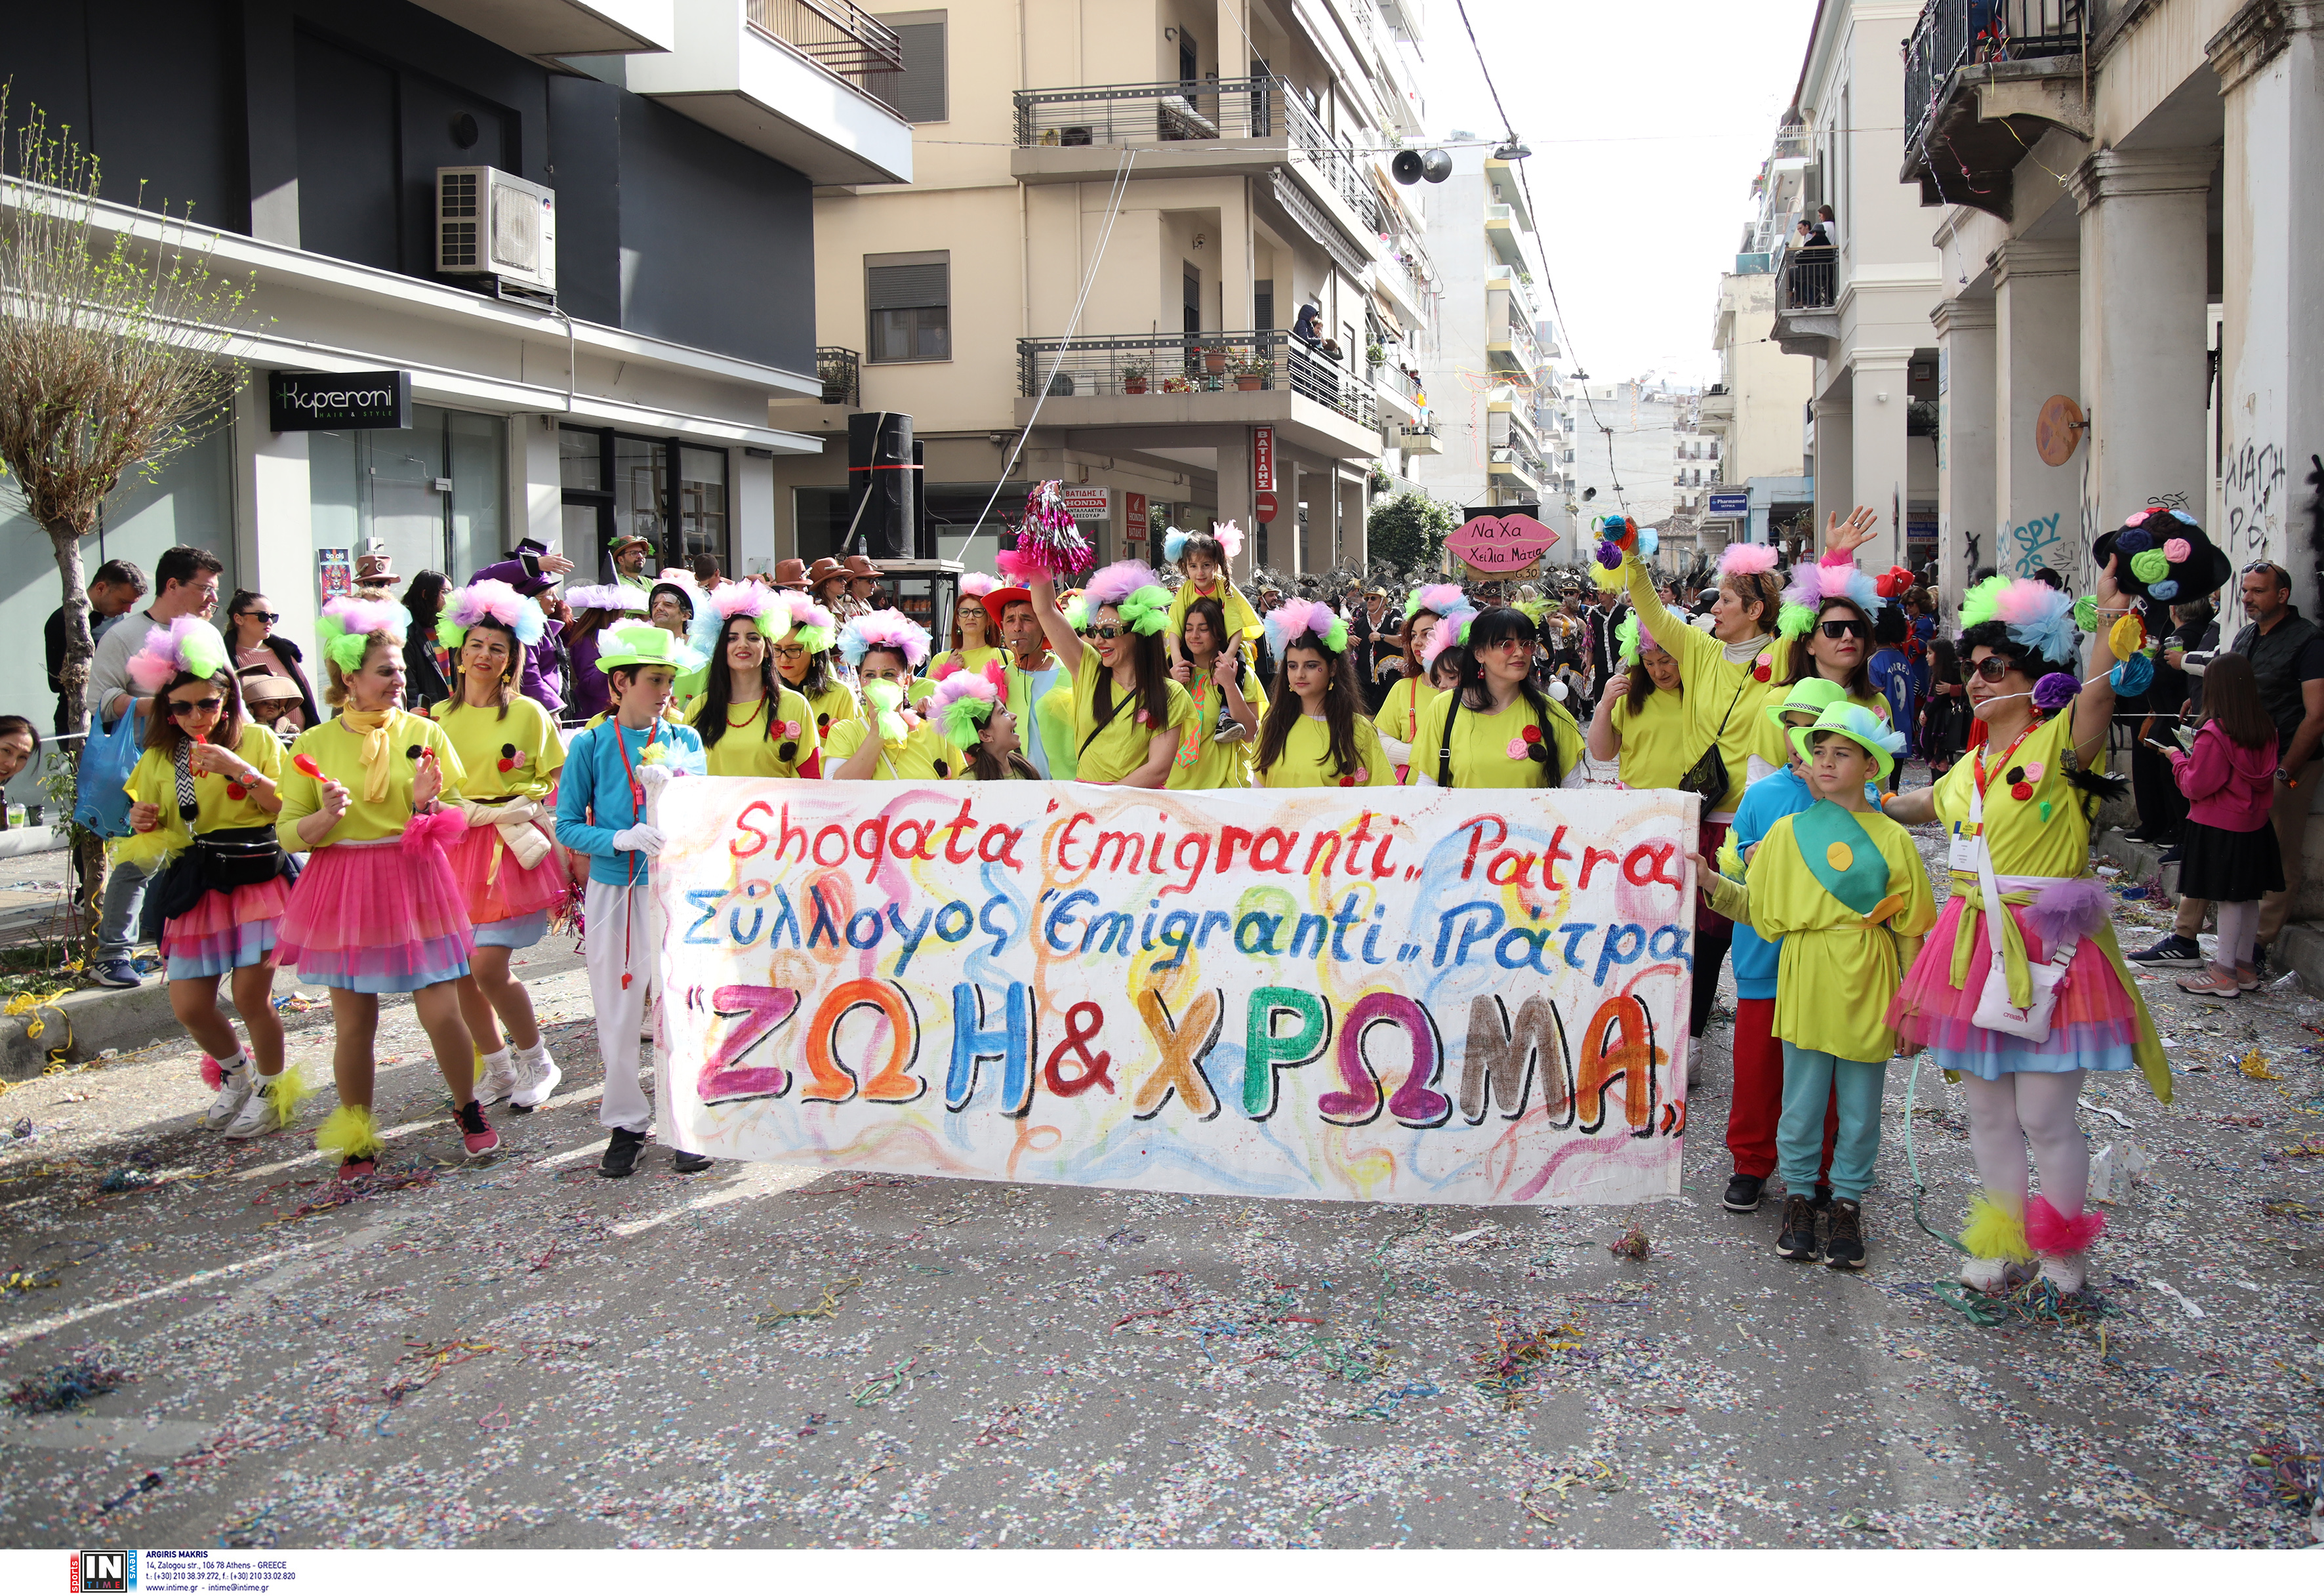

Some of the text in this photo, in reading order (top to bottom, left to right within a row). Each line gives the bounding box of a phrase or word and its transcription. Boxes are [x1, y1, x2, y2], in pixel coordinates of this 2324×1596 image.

[1257, 431, 1269, 487] ΒΑΤΙΔΗΣ
[1128, 512, 1145, 522] HONDA
[2013, 512, 2060, 552] SPY
[1894, 674, 1907, 712] 9
[729, 797, 1024, 884] Shoqata
[1458, 812, 1682, 891] Patra
[2003, 1012, 2024, 1021] create
[1044, 1000, 1116, 1097] &
